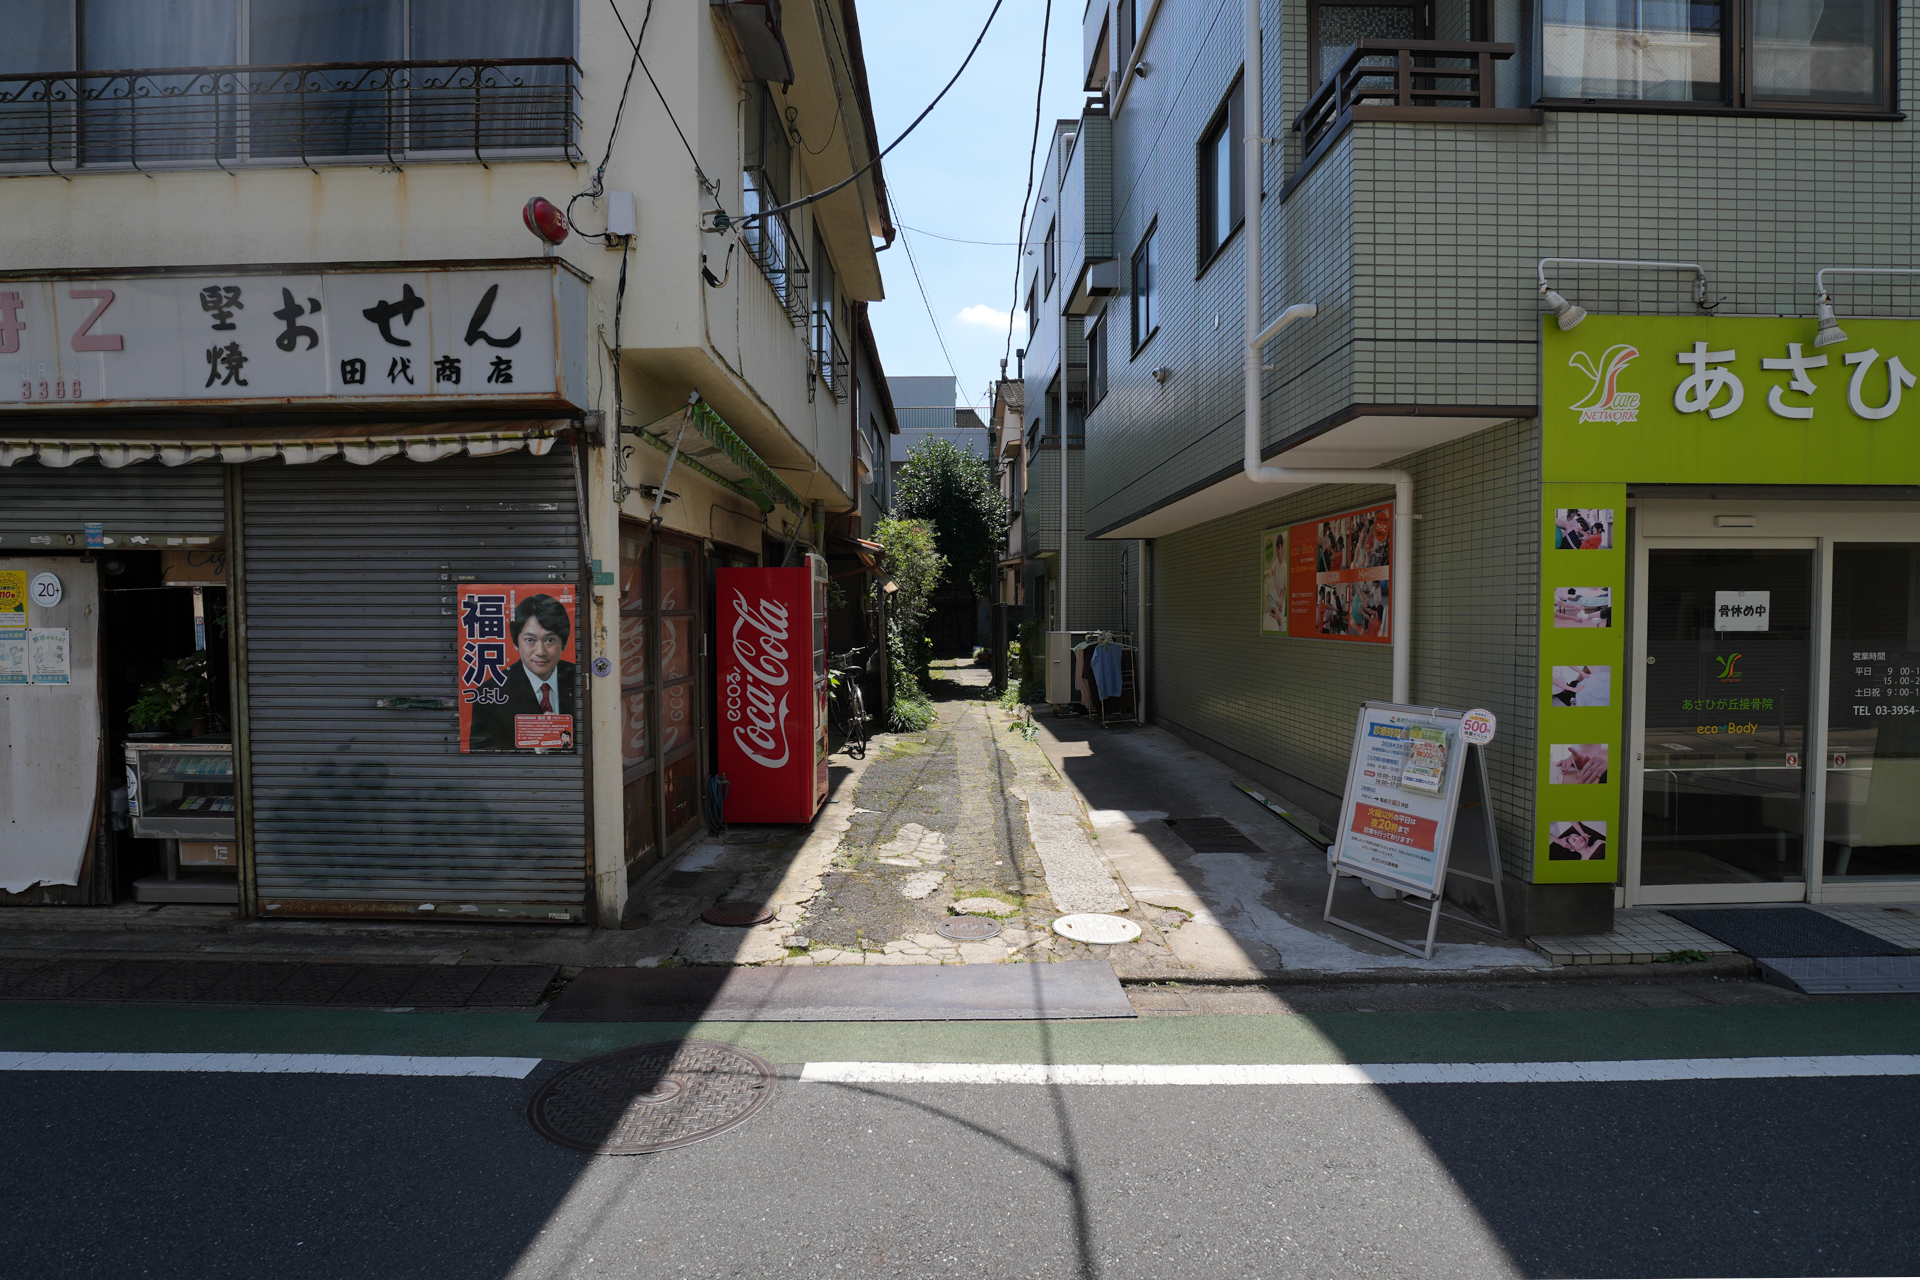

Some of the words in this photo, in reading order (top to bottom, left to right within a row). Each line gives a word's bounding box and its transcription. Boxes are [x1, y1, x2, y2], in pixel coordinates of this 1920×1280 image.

[273, 283, 522, 352] おせん
[200, 284, 249, 388] 堅焼
[340, 355, 515, 387] 田代商店
[1672, 341, 1918, 421] あさひ
[21, 381, 82, 399] 3366
[1582, 411, 1636, 421] NETWORK
[37, 582, 61, 597] 20+
[1718, 604, 1766, 617] 骨休め中
[461, 593, 508, 687] 福沢
[1852, 651, 1886, 661] 営業時間
[732, 587, 791, 769] Coca-Cola
[1854, 666, 1872, 676] 平日
[462, 688, 510, 705] つよし
[1854, 687, 1881, 697] 土日祝
[1682, 698, 1774, 711] あさひが丘接骨院
[1852, 705, 1871, 716] TEL
[1696, 725, 1719, 735] eco
[1727, 721, 1759, 735] Body
[1370, 818, 1410, 835] 夜20時まで
